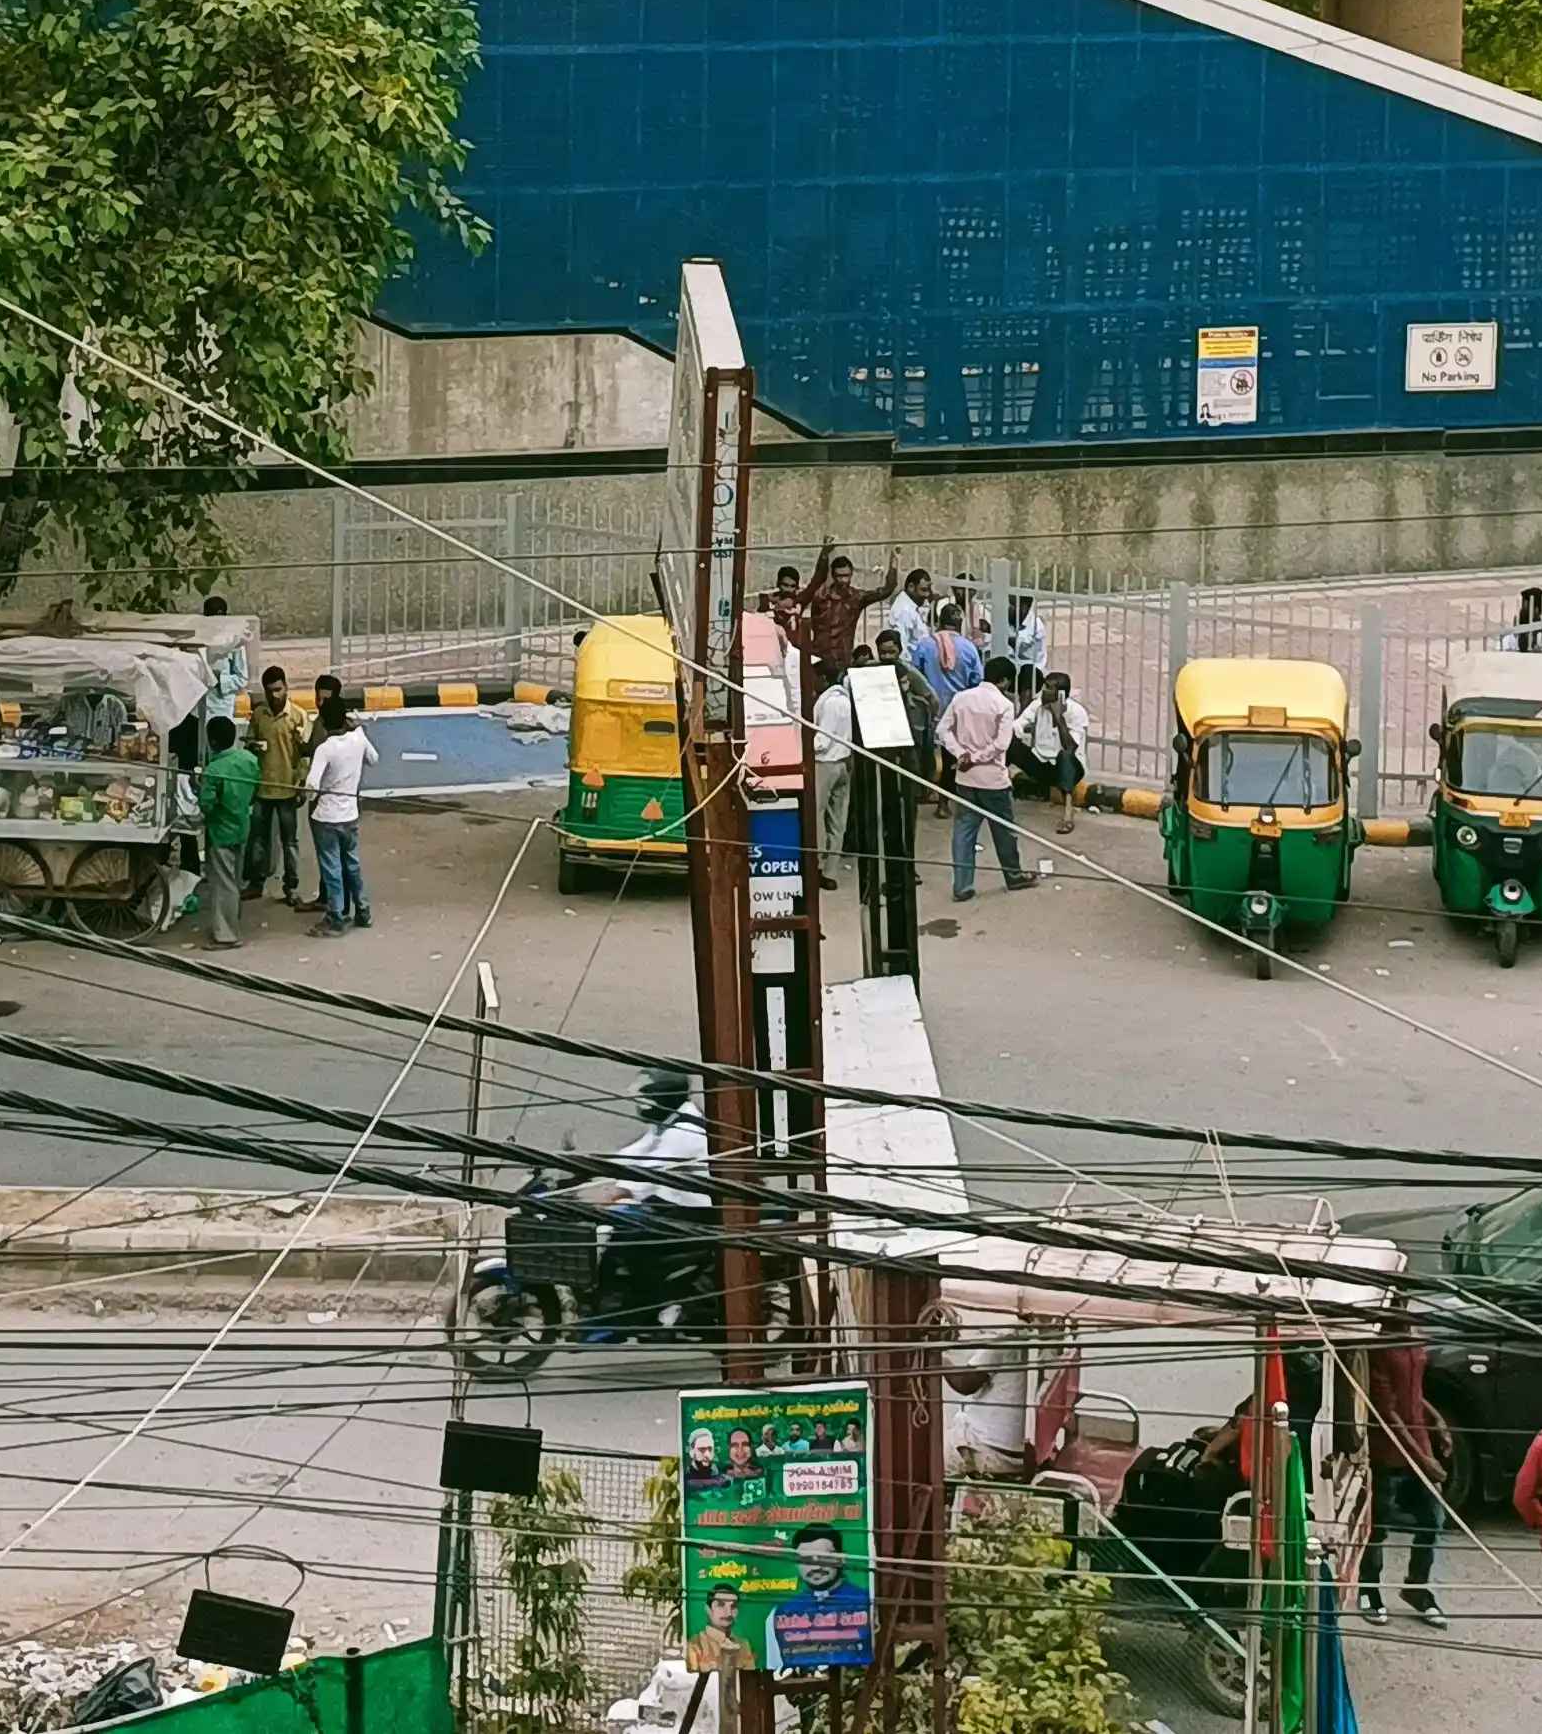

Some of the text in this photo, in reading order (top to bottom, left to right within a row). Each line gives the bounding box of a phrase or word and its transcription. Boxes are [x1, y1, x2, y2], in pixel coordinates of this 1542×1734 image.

[1422, 370, 1480, 384] No Parking
[761, 861, 799, 874] OPEN
